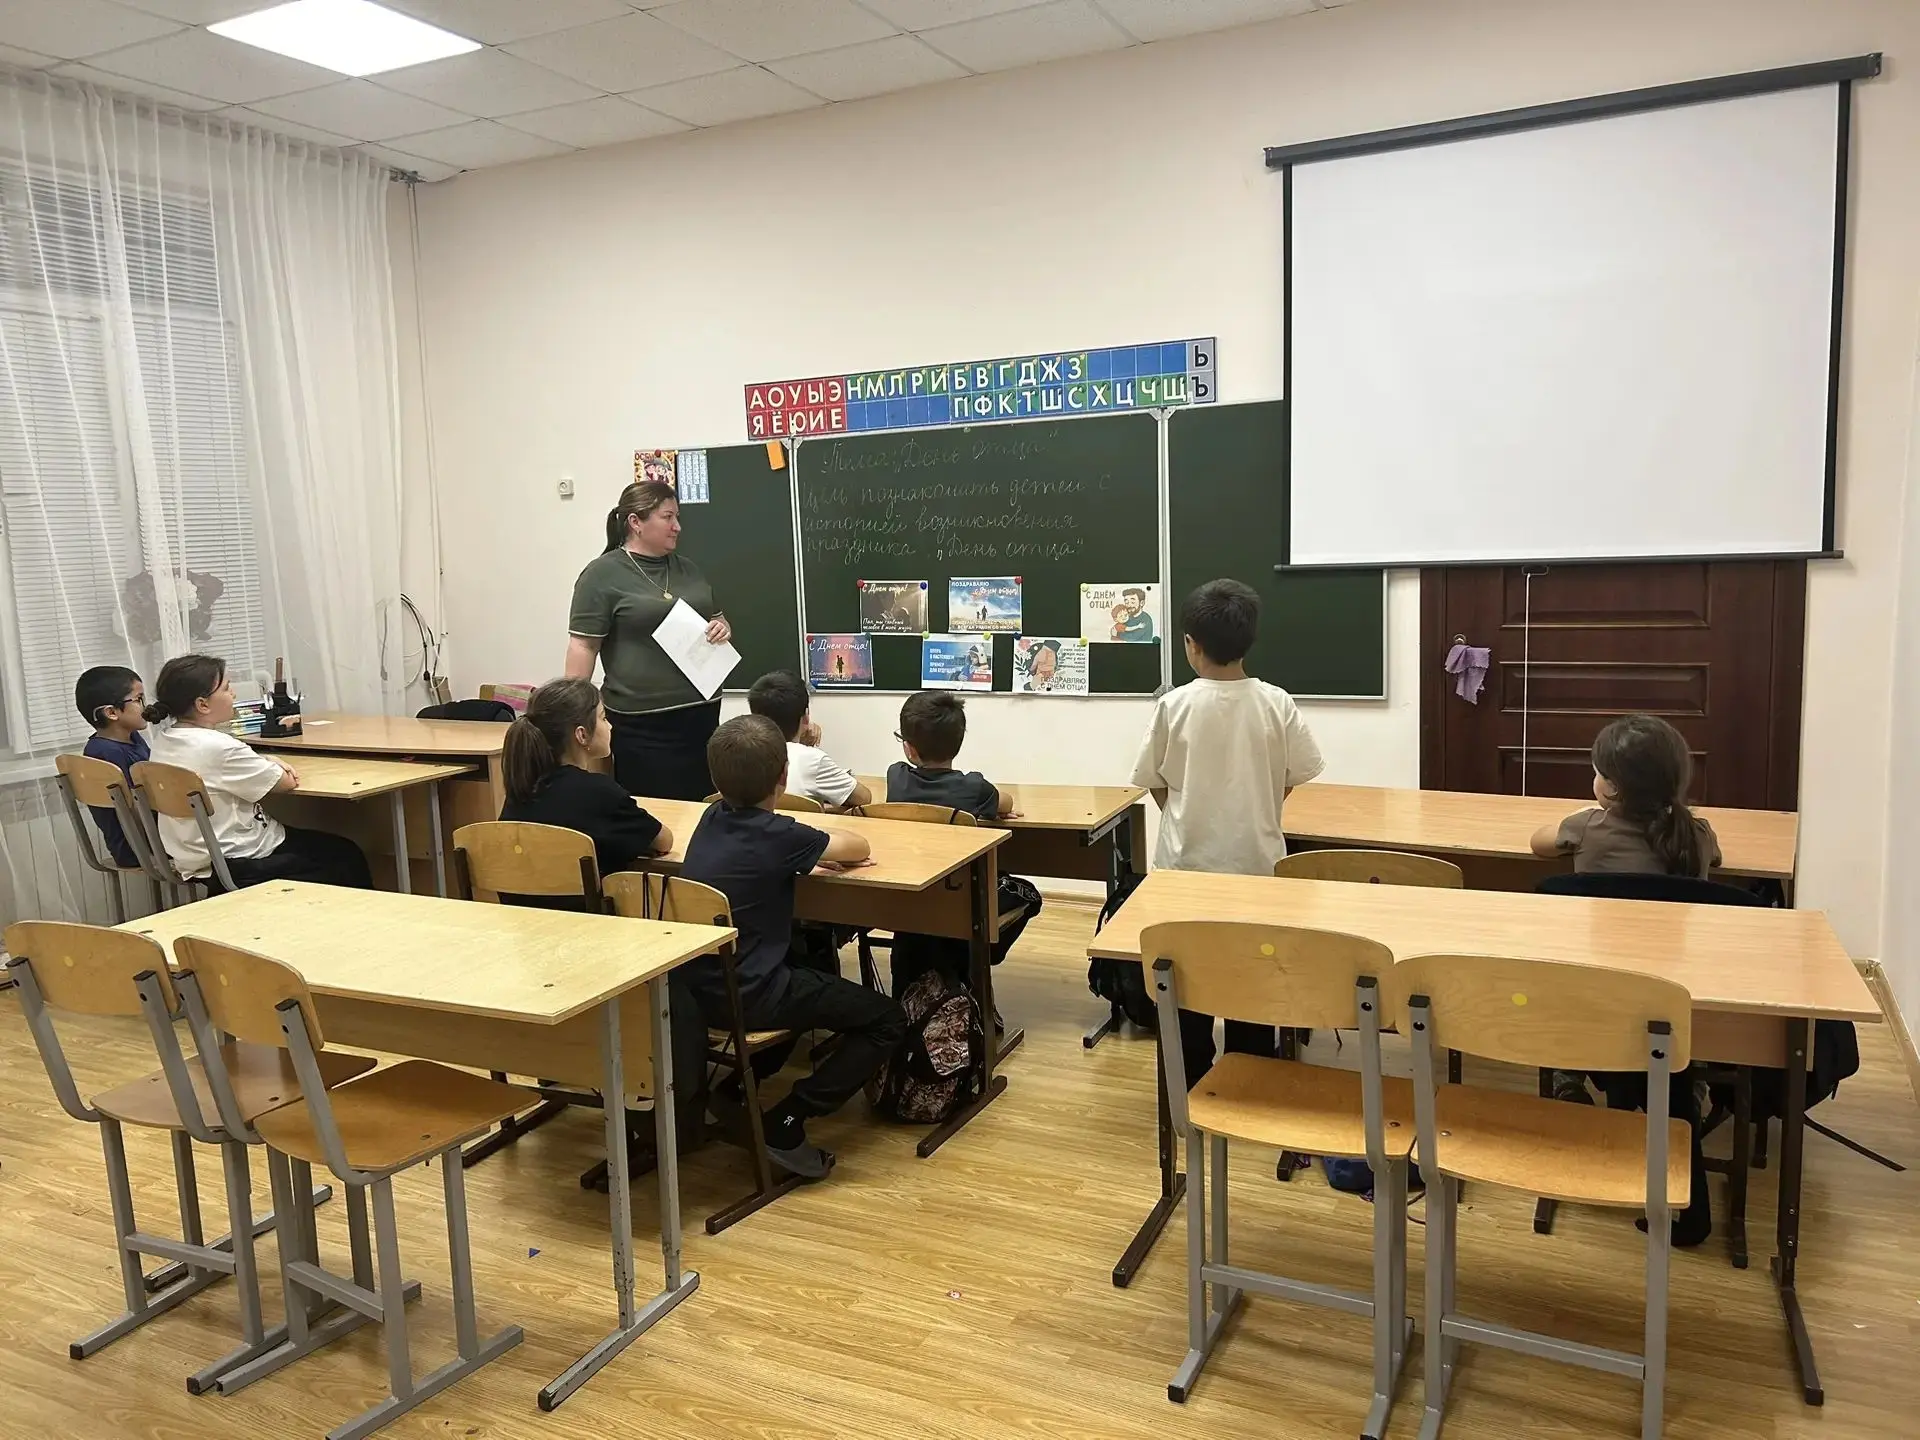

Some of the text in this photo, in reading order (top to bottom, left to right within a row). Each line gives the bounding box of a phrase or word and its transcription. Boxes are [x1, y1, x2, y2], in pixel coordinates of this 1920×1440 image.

[1090, 600, 1113, 609] ОТЦА!
[843, 640, 868, 652] отца!
[1041, 676, 1087, 685] ПОЗДРАВЛЯЮ
